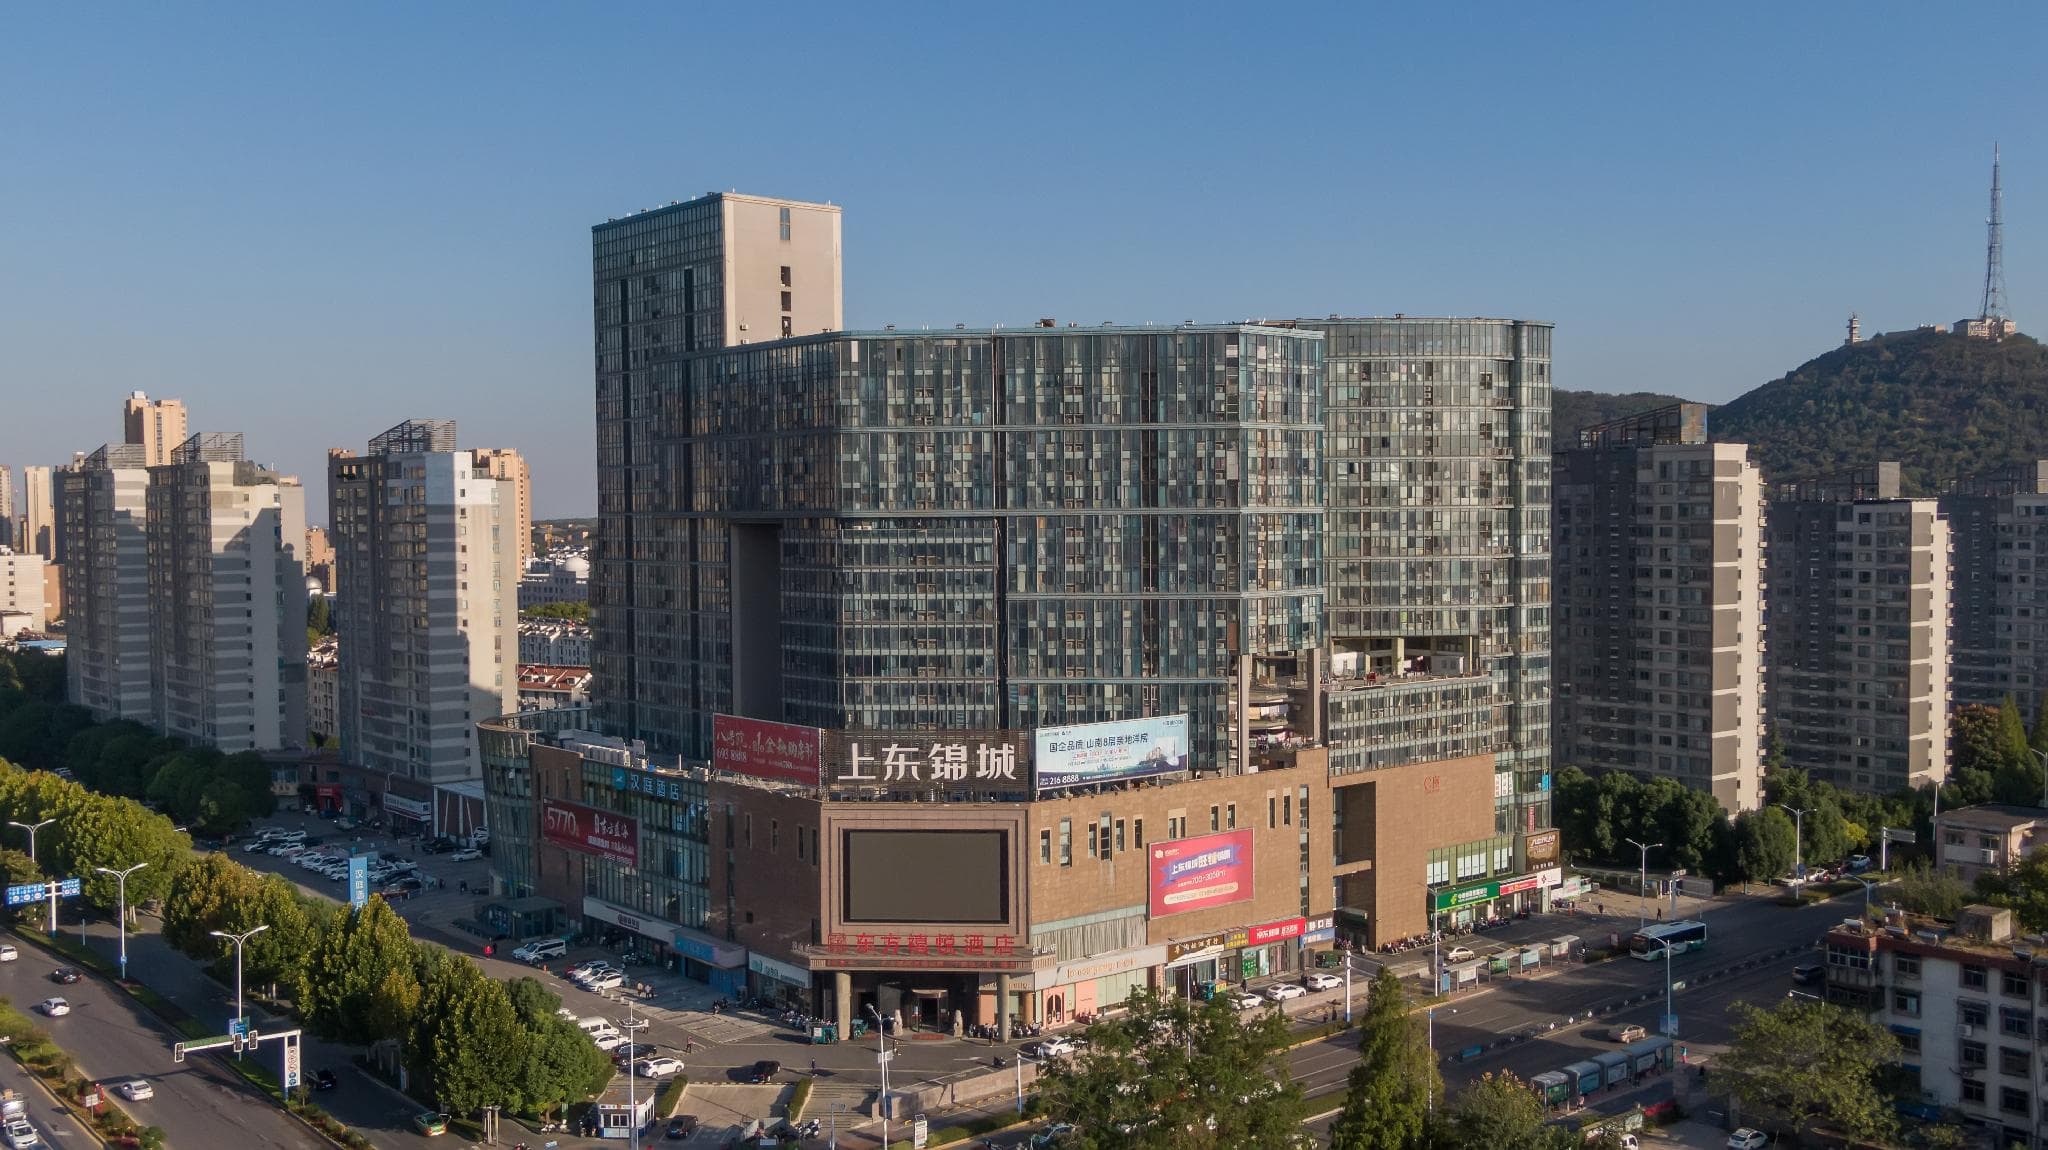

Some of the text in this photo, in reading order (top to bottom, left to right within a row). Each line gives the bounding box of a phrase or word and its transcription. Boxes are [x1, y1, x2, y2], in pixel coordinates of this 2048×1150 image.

[1049, 741, 1084, 753] 国企品质
[837, 742, 1017, 781] 上东锦城
[630, 773, 680, 801] 汉庭酒店
[1050, 776, 1062, 786] 216
[1062, 774, 1080, 784] 8888
[547, 807, 577, 834] 5770
